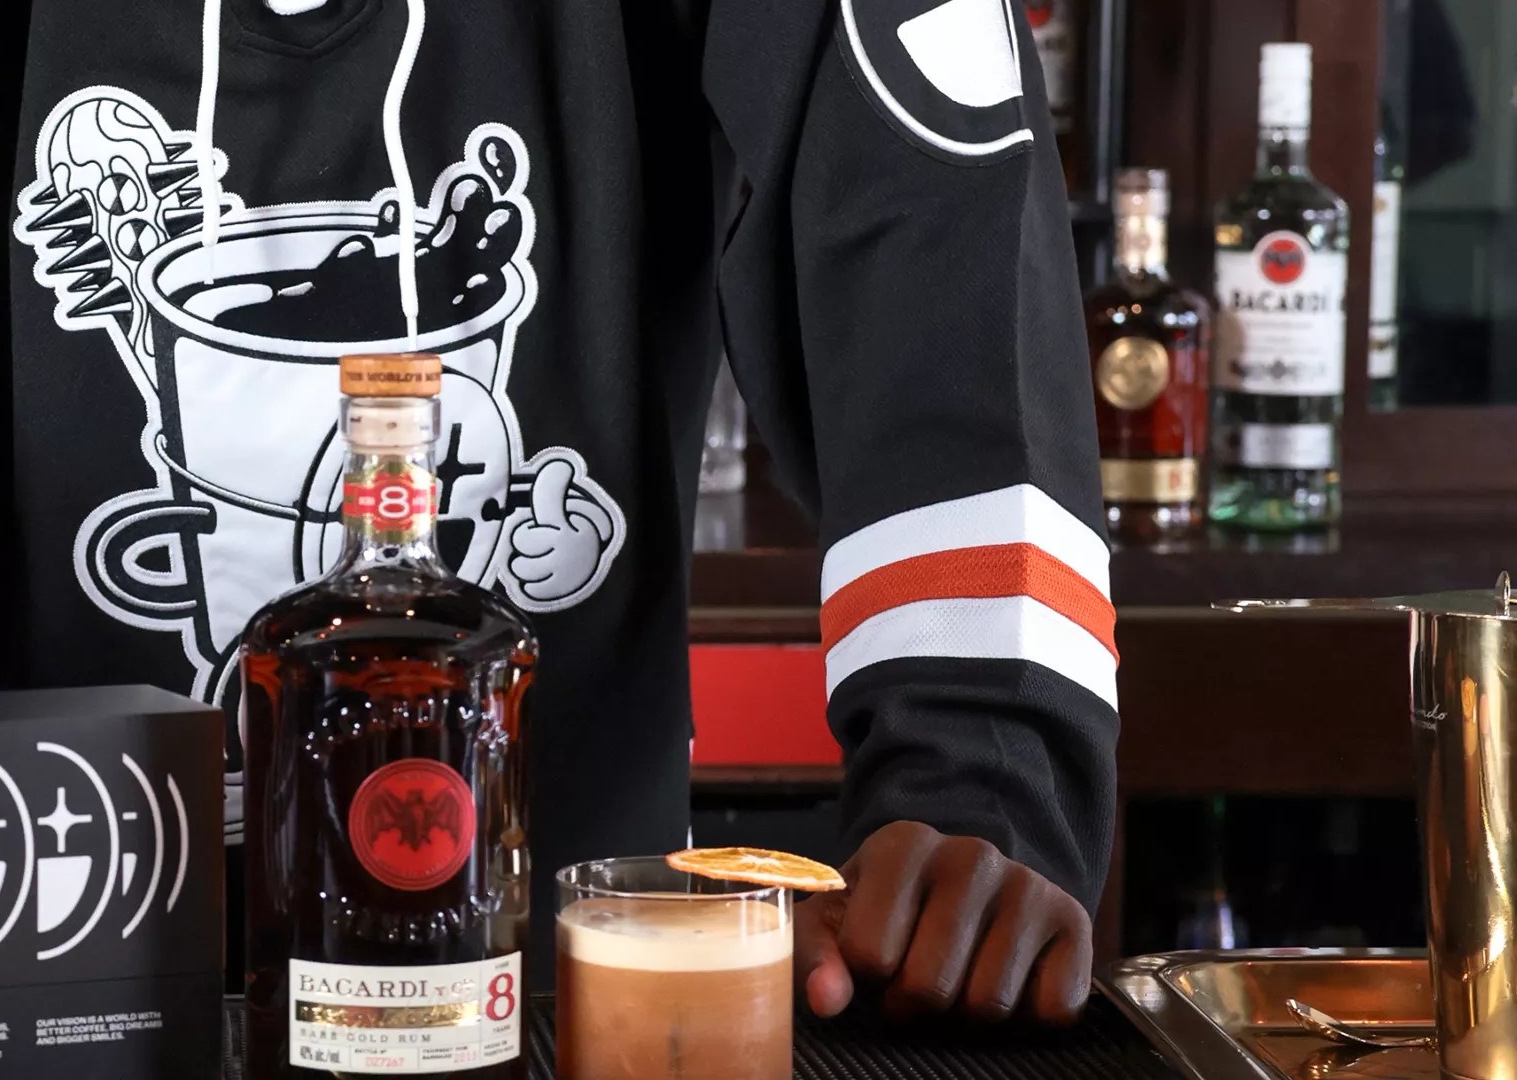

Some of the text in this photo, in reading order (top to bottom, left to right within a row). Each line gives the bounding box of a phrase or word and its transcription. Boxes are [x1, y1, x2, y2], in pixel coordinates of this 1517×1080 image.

[378, 485, 410, 519] 8
[299, 973, 428, 999] BACARDI
[485, 972, 516, 1022] 8
[36, 1026, 72, 1037] BETTER
[36, 1036, 56, 1046] AND
[56, 1033, 90, 1044] BIGGER
[346, 1032, 389, 1043] GOLD
[398, 1034, 431, 1043] RUM
